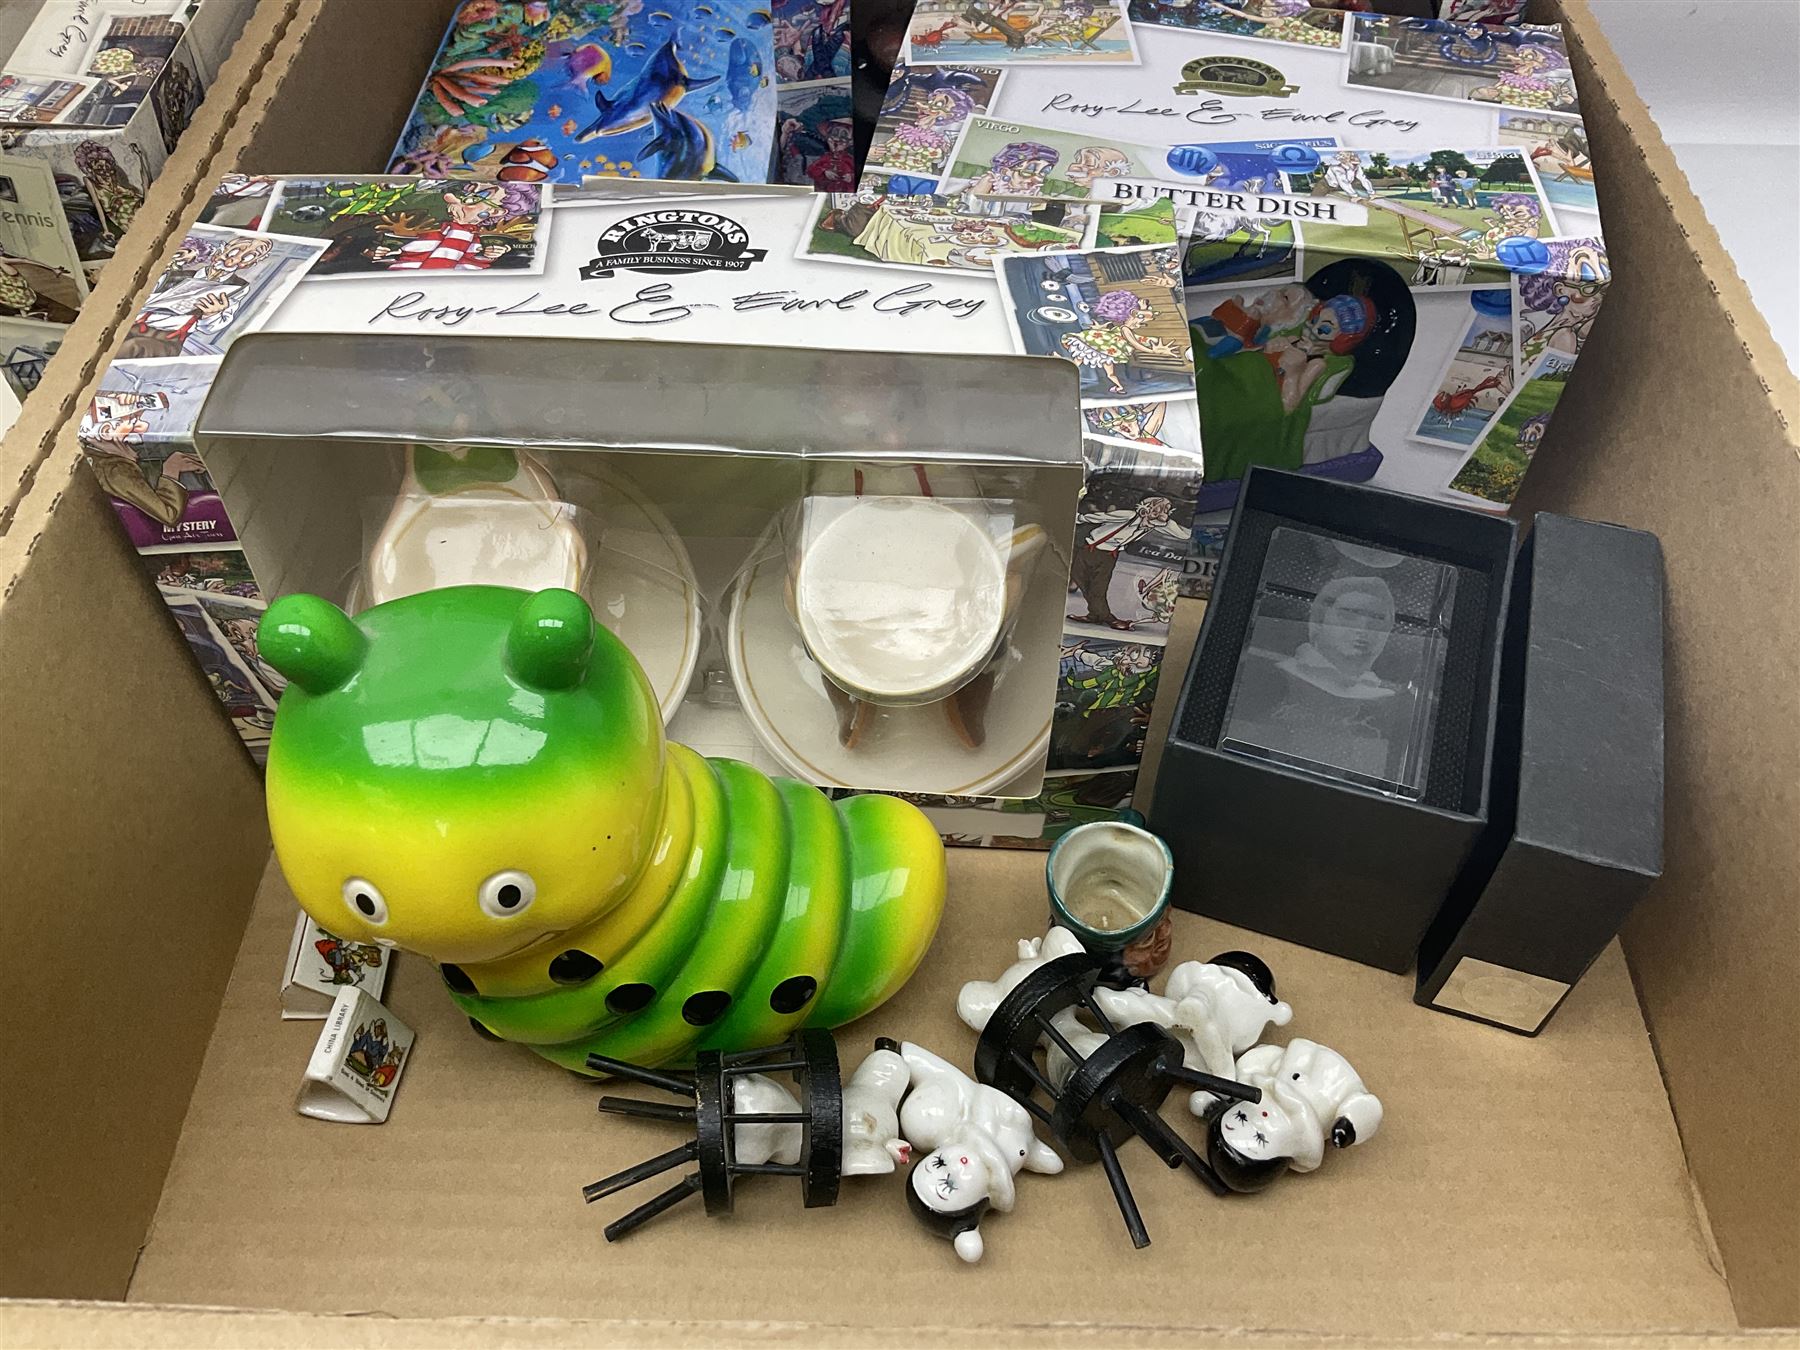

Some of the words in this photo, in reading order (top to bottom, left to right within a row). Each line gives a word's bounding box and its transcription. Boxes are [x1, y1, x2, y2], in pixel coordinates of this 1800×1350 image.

[976, 120, 1020, 134] VIRGO
[1348, 110, 1419, 131] Grey
[1114, 182, 1246, 211] BUTTER
[1256, 197, 1336, 220] DISH
[601, 211, 747, 244] RINGTONS
[606, 256, 642, 267] FAMILY
[643, 256, 691, 265] BUSINESS
[692, 258, 721, 267] SINCE
[731, 289, 869, 311] Earl
[873, 282, 985, 318] Grey
[323, 1033, 337, 1054] CHINA
[333, 1003, 349, 1031] LIBRARY
